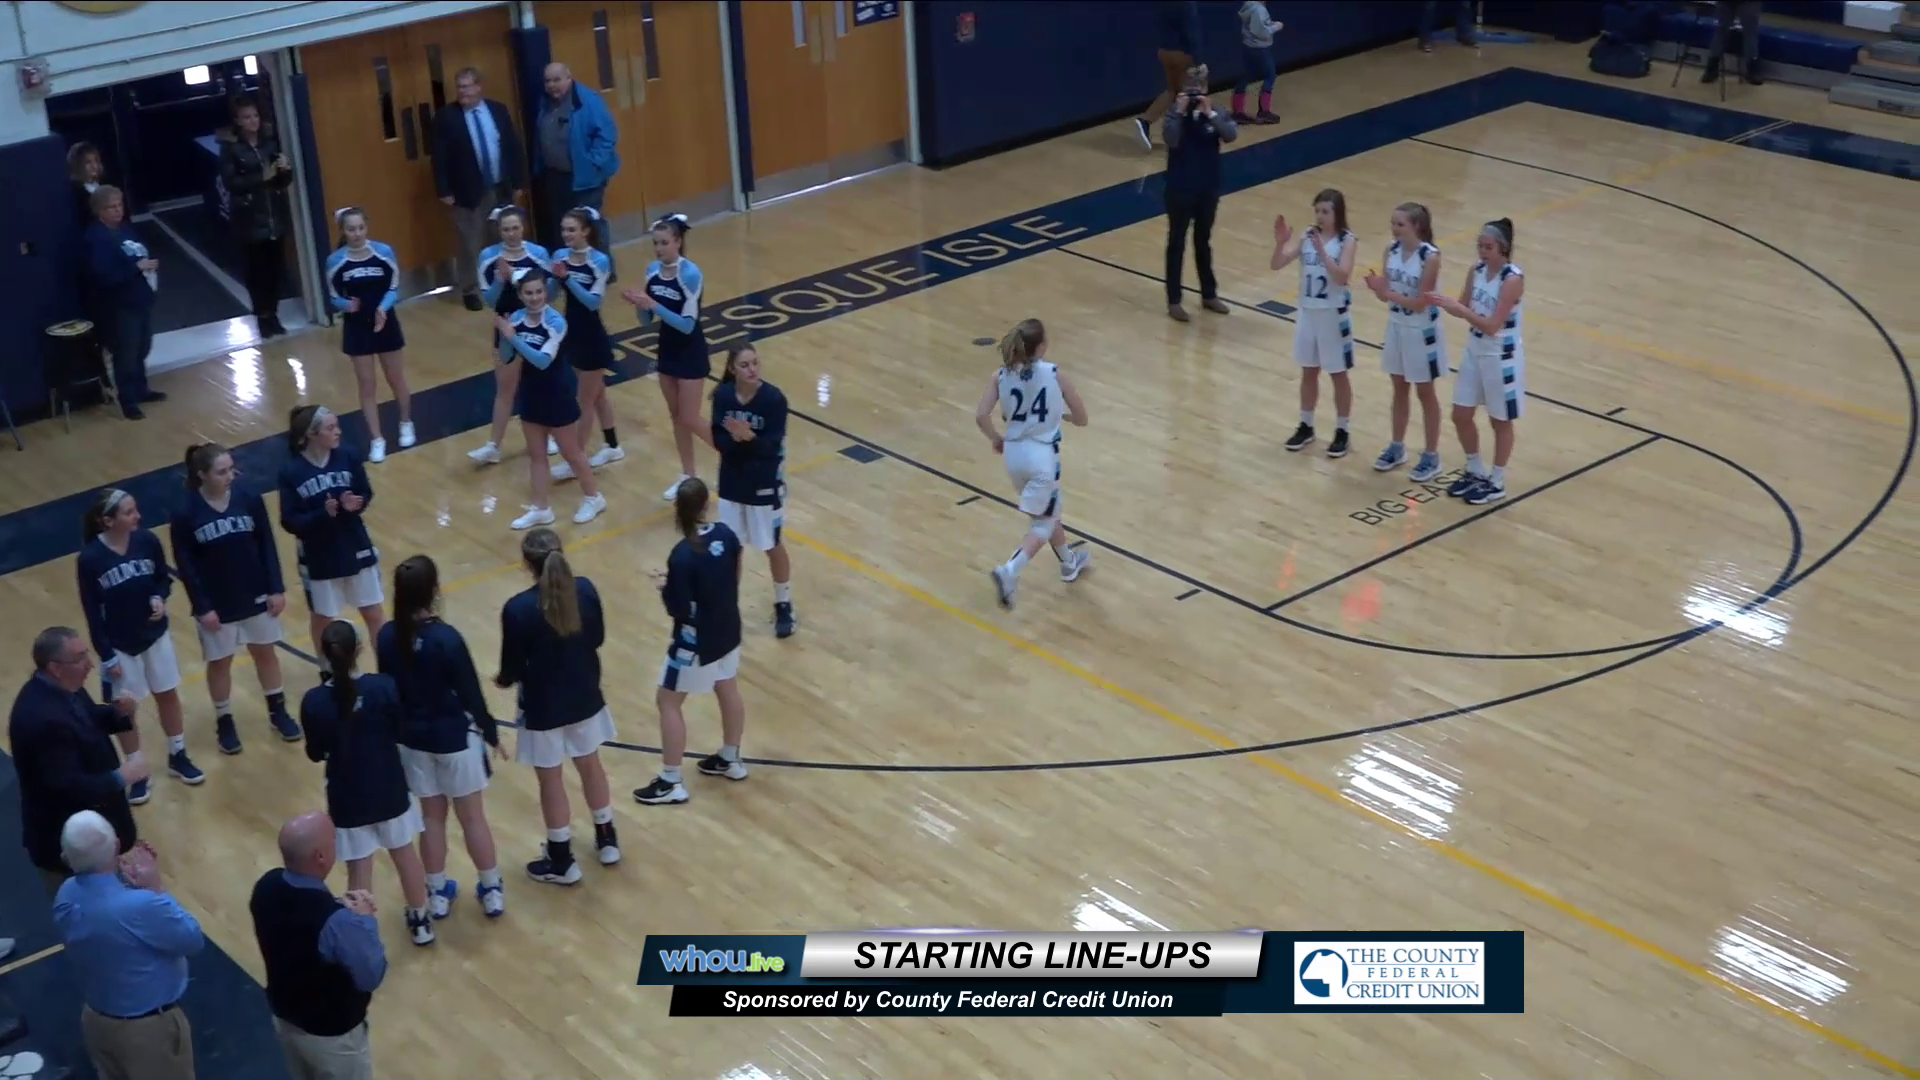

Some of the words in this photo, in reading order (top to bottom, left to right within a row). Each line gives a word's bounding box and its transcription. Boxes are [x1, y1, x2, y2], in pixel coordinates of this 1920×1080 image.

[921, 215, 1088, 267] ISLE
[1304, 273, 1328, 299] 12
[1010, 386, 1049, 422] 24
[1348, 499, 1410, 525] BIG
[1399, 469, 1467, 504] EAST
